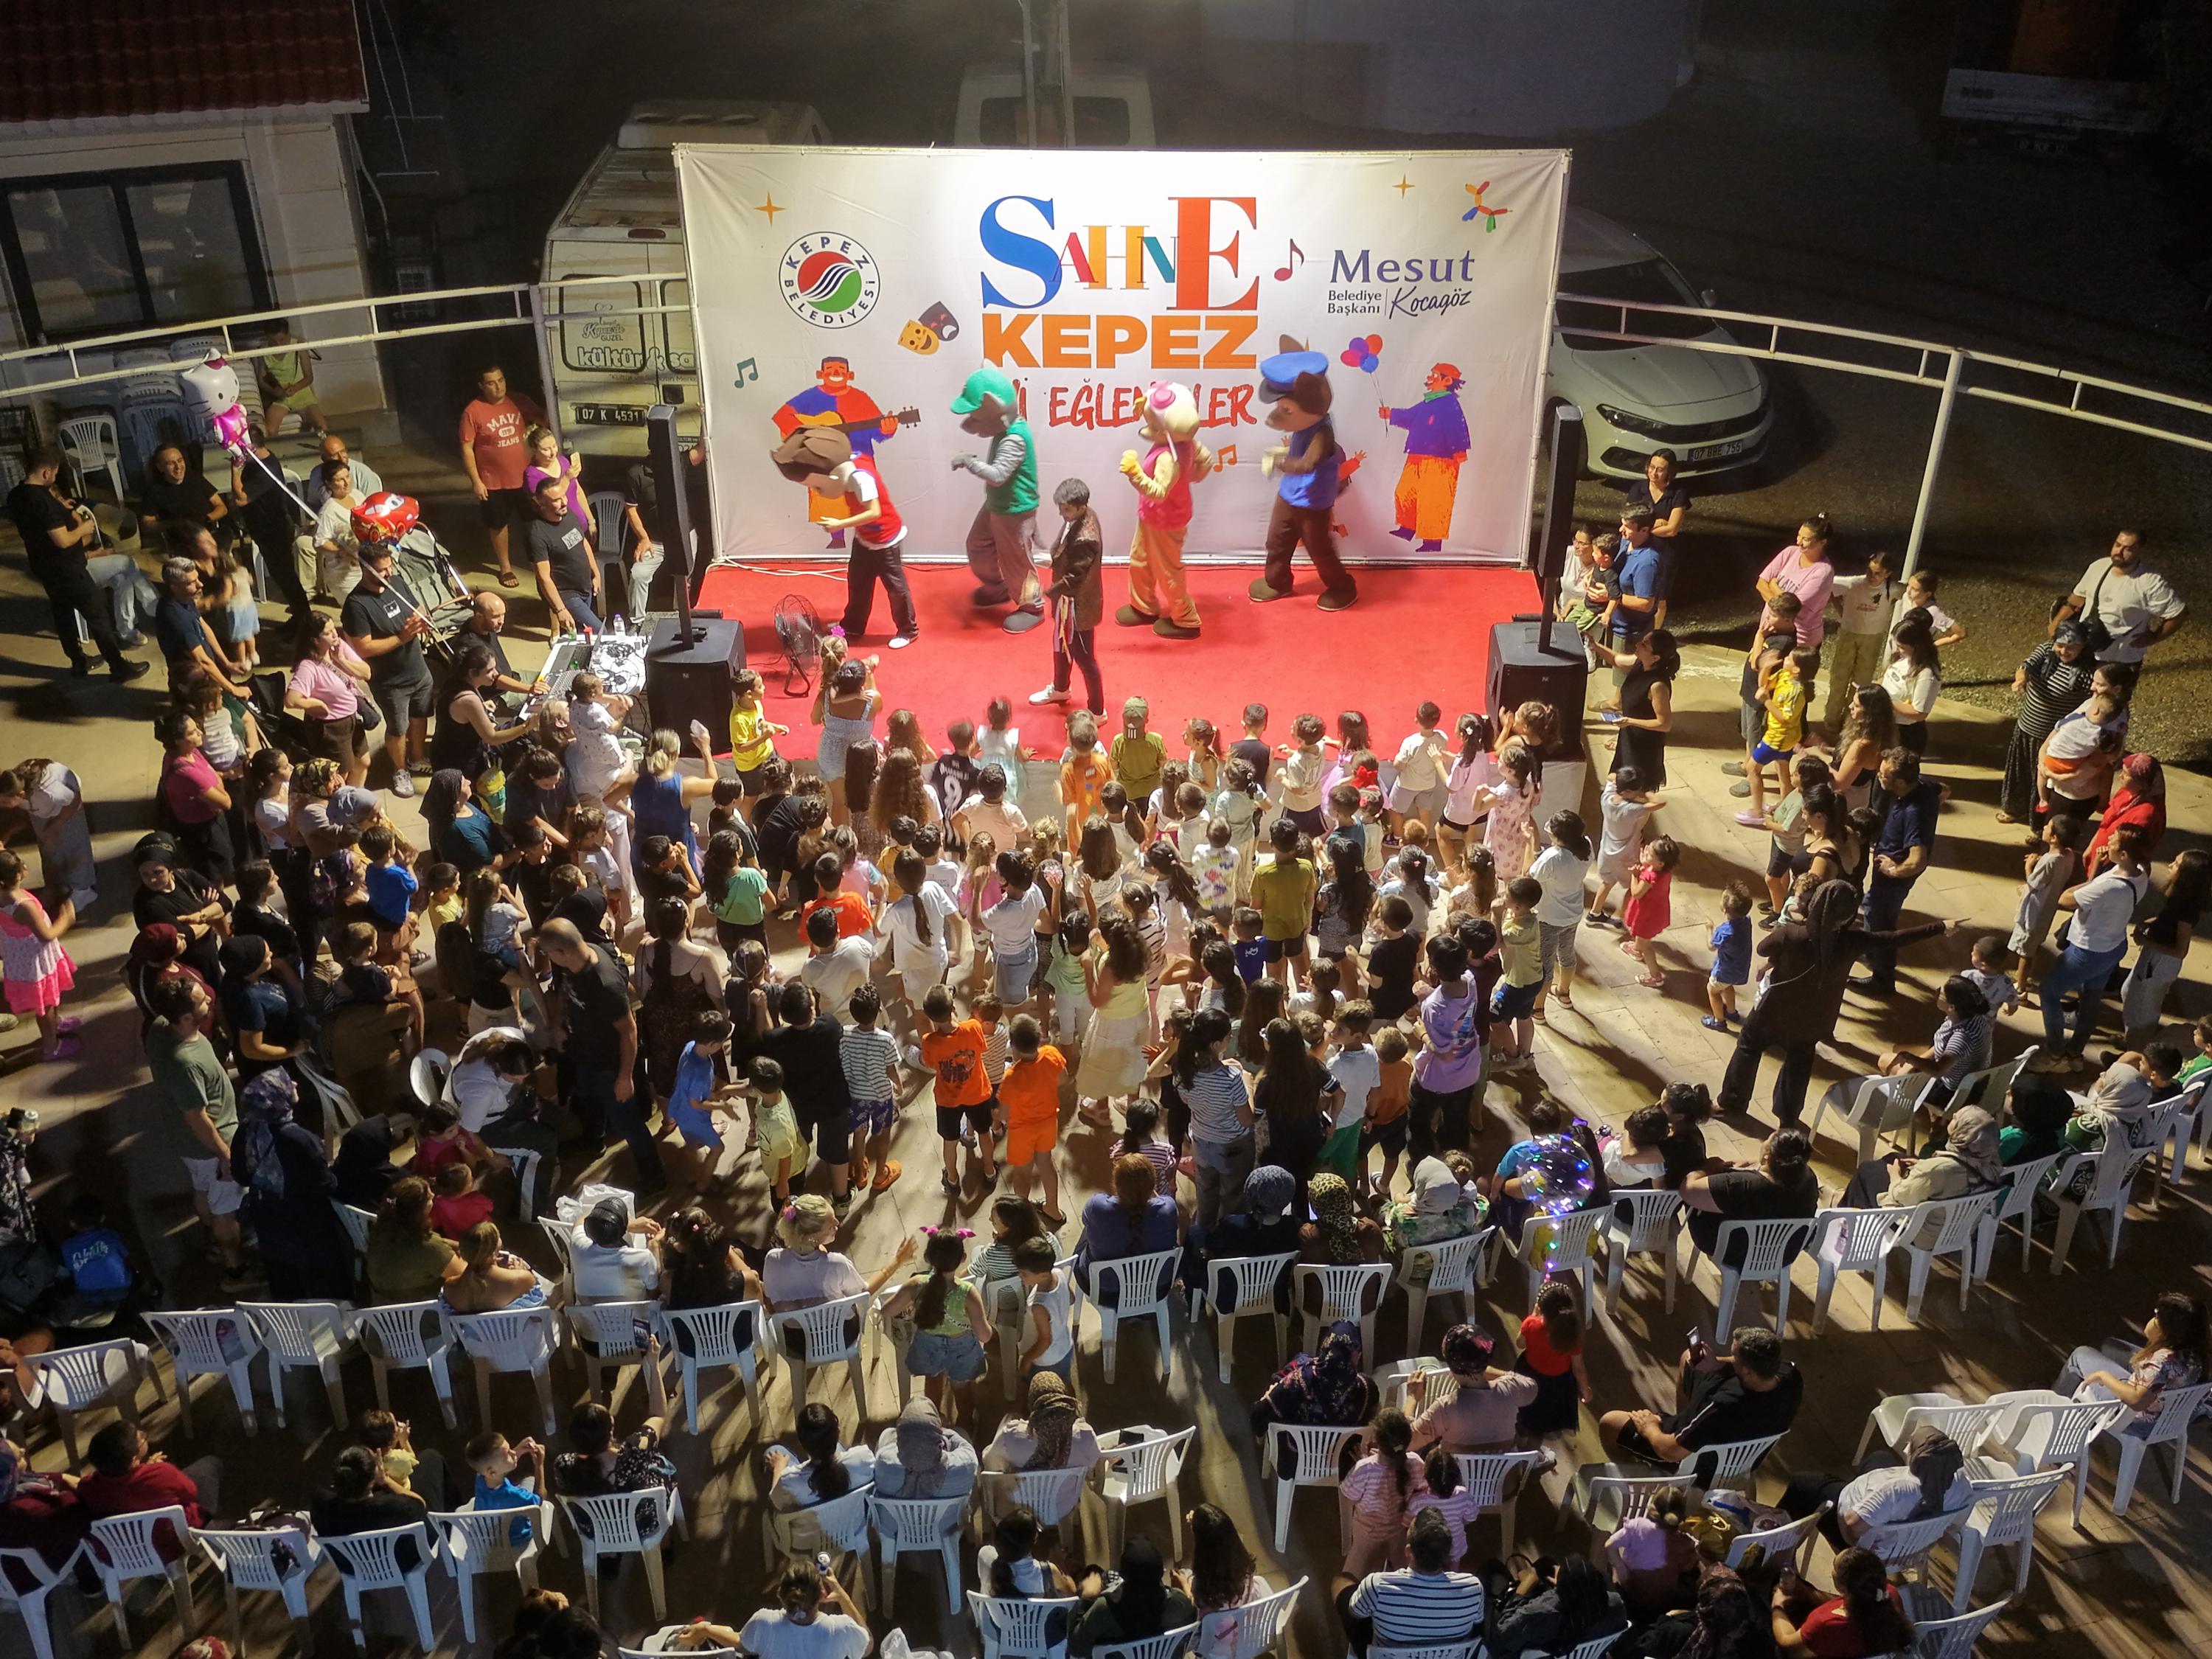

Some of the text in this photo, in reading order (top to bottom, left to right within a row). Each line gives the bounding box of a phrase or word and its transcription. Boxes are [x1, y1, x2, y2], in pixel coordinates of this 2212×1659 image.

[785, 236, 870, 269] KEPEZ
[979, 195, 1260, 310] SAHNE
[1329, 249, 1475, 283] Mesut
[1327, 303, 1380, 316] Başkanı
[1328, 290, 1382, 304] Belediye
[1388, 285, 1472, 320] Kocagöz
[982, 313, 1258, 369] KEPEZ
[582, 408, 639, 422] 07 K 4531
[497, 436, 520, 448] JEANS
